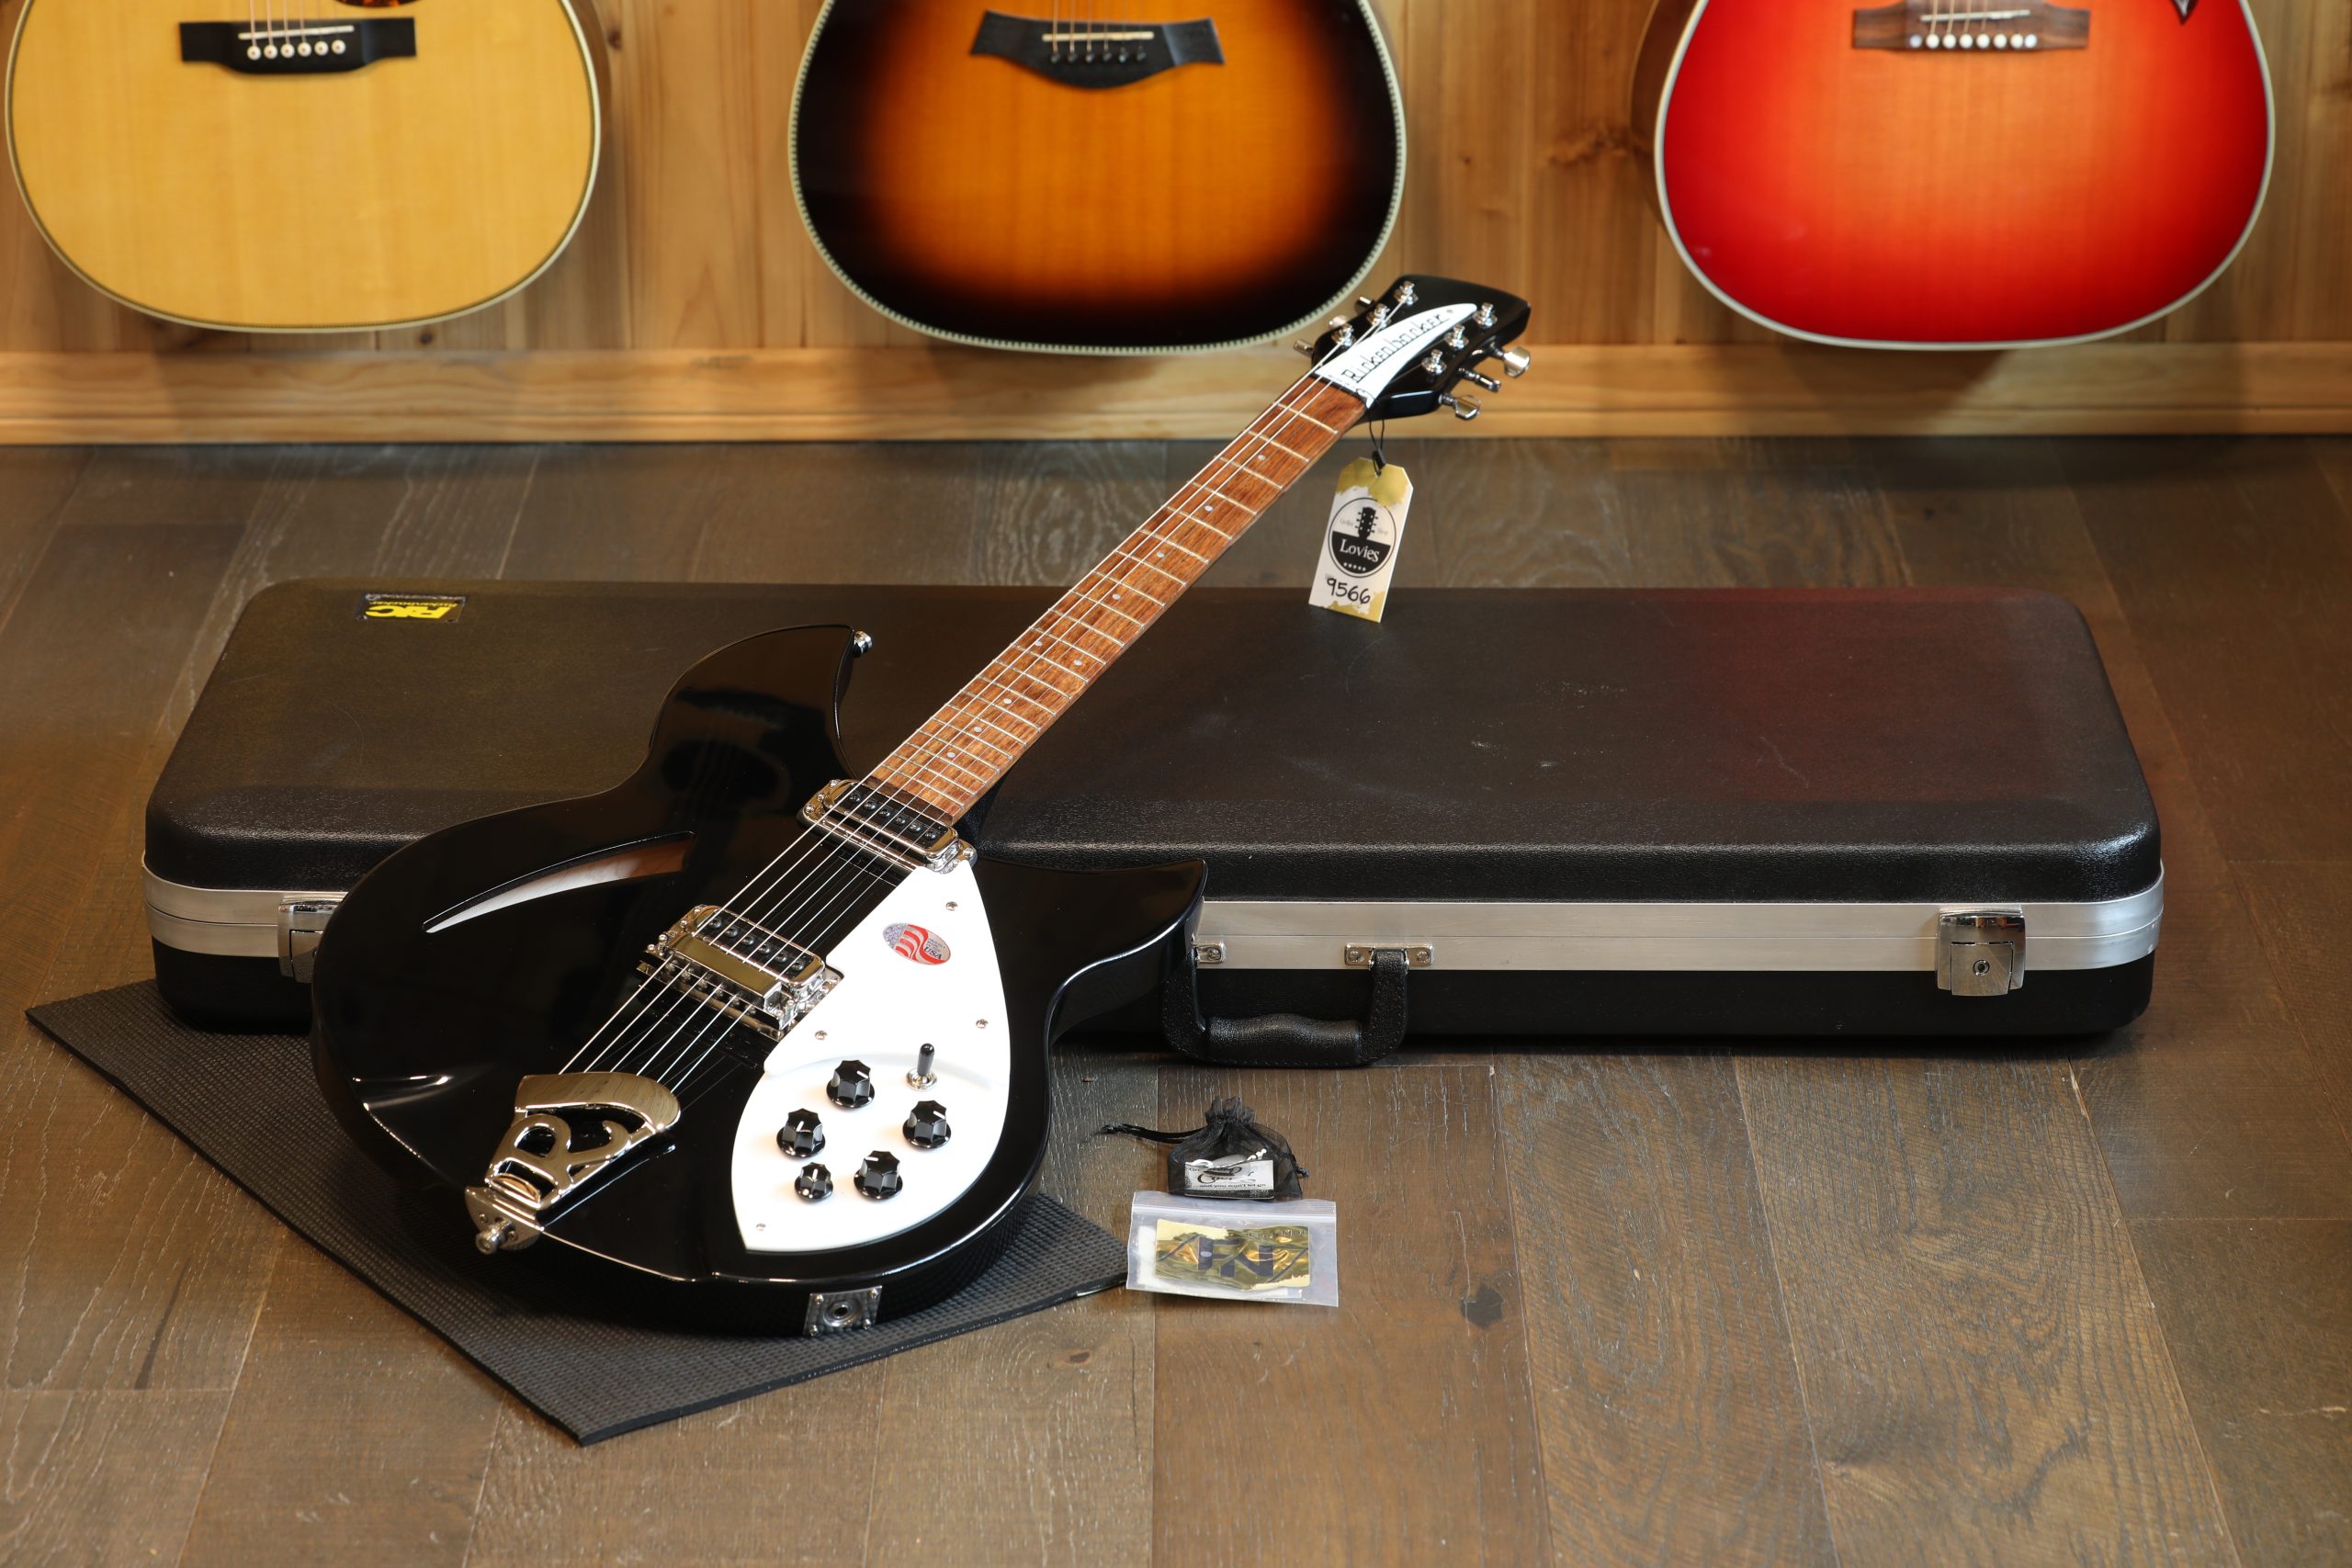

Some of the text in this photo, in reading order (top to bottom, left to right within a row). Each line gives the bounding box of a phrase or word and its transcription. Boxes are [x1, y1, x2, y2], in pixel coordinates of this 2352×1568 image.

[1340, 311, 1451, 384] Rickenbacker
[1340, 538, 1381, 563] Lovies
[1327, 577, 1371, 604] 9566
[366, 605, 451, 618] RIC
[924, 946, 942, 959] USA
